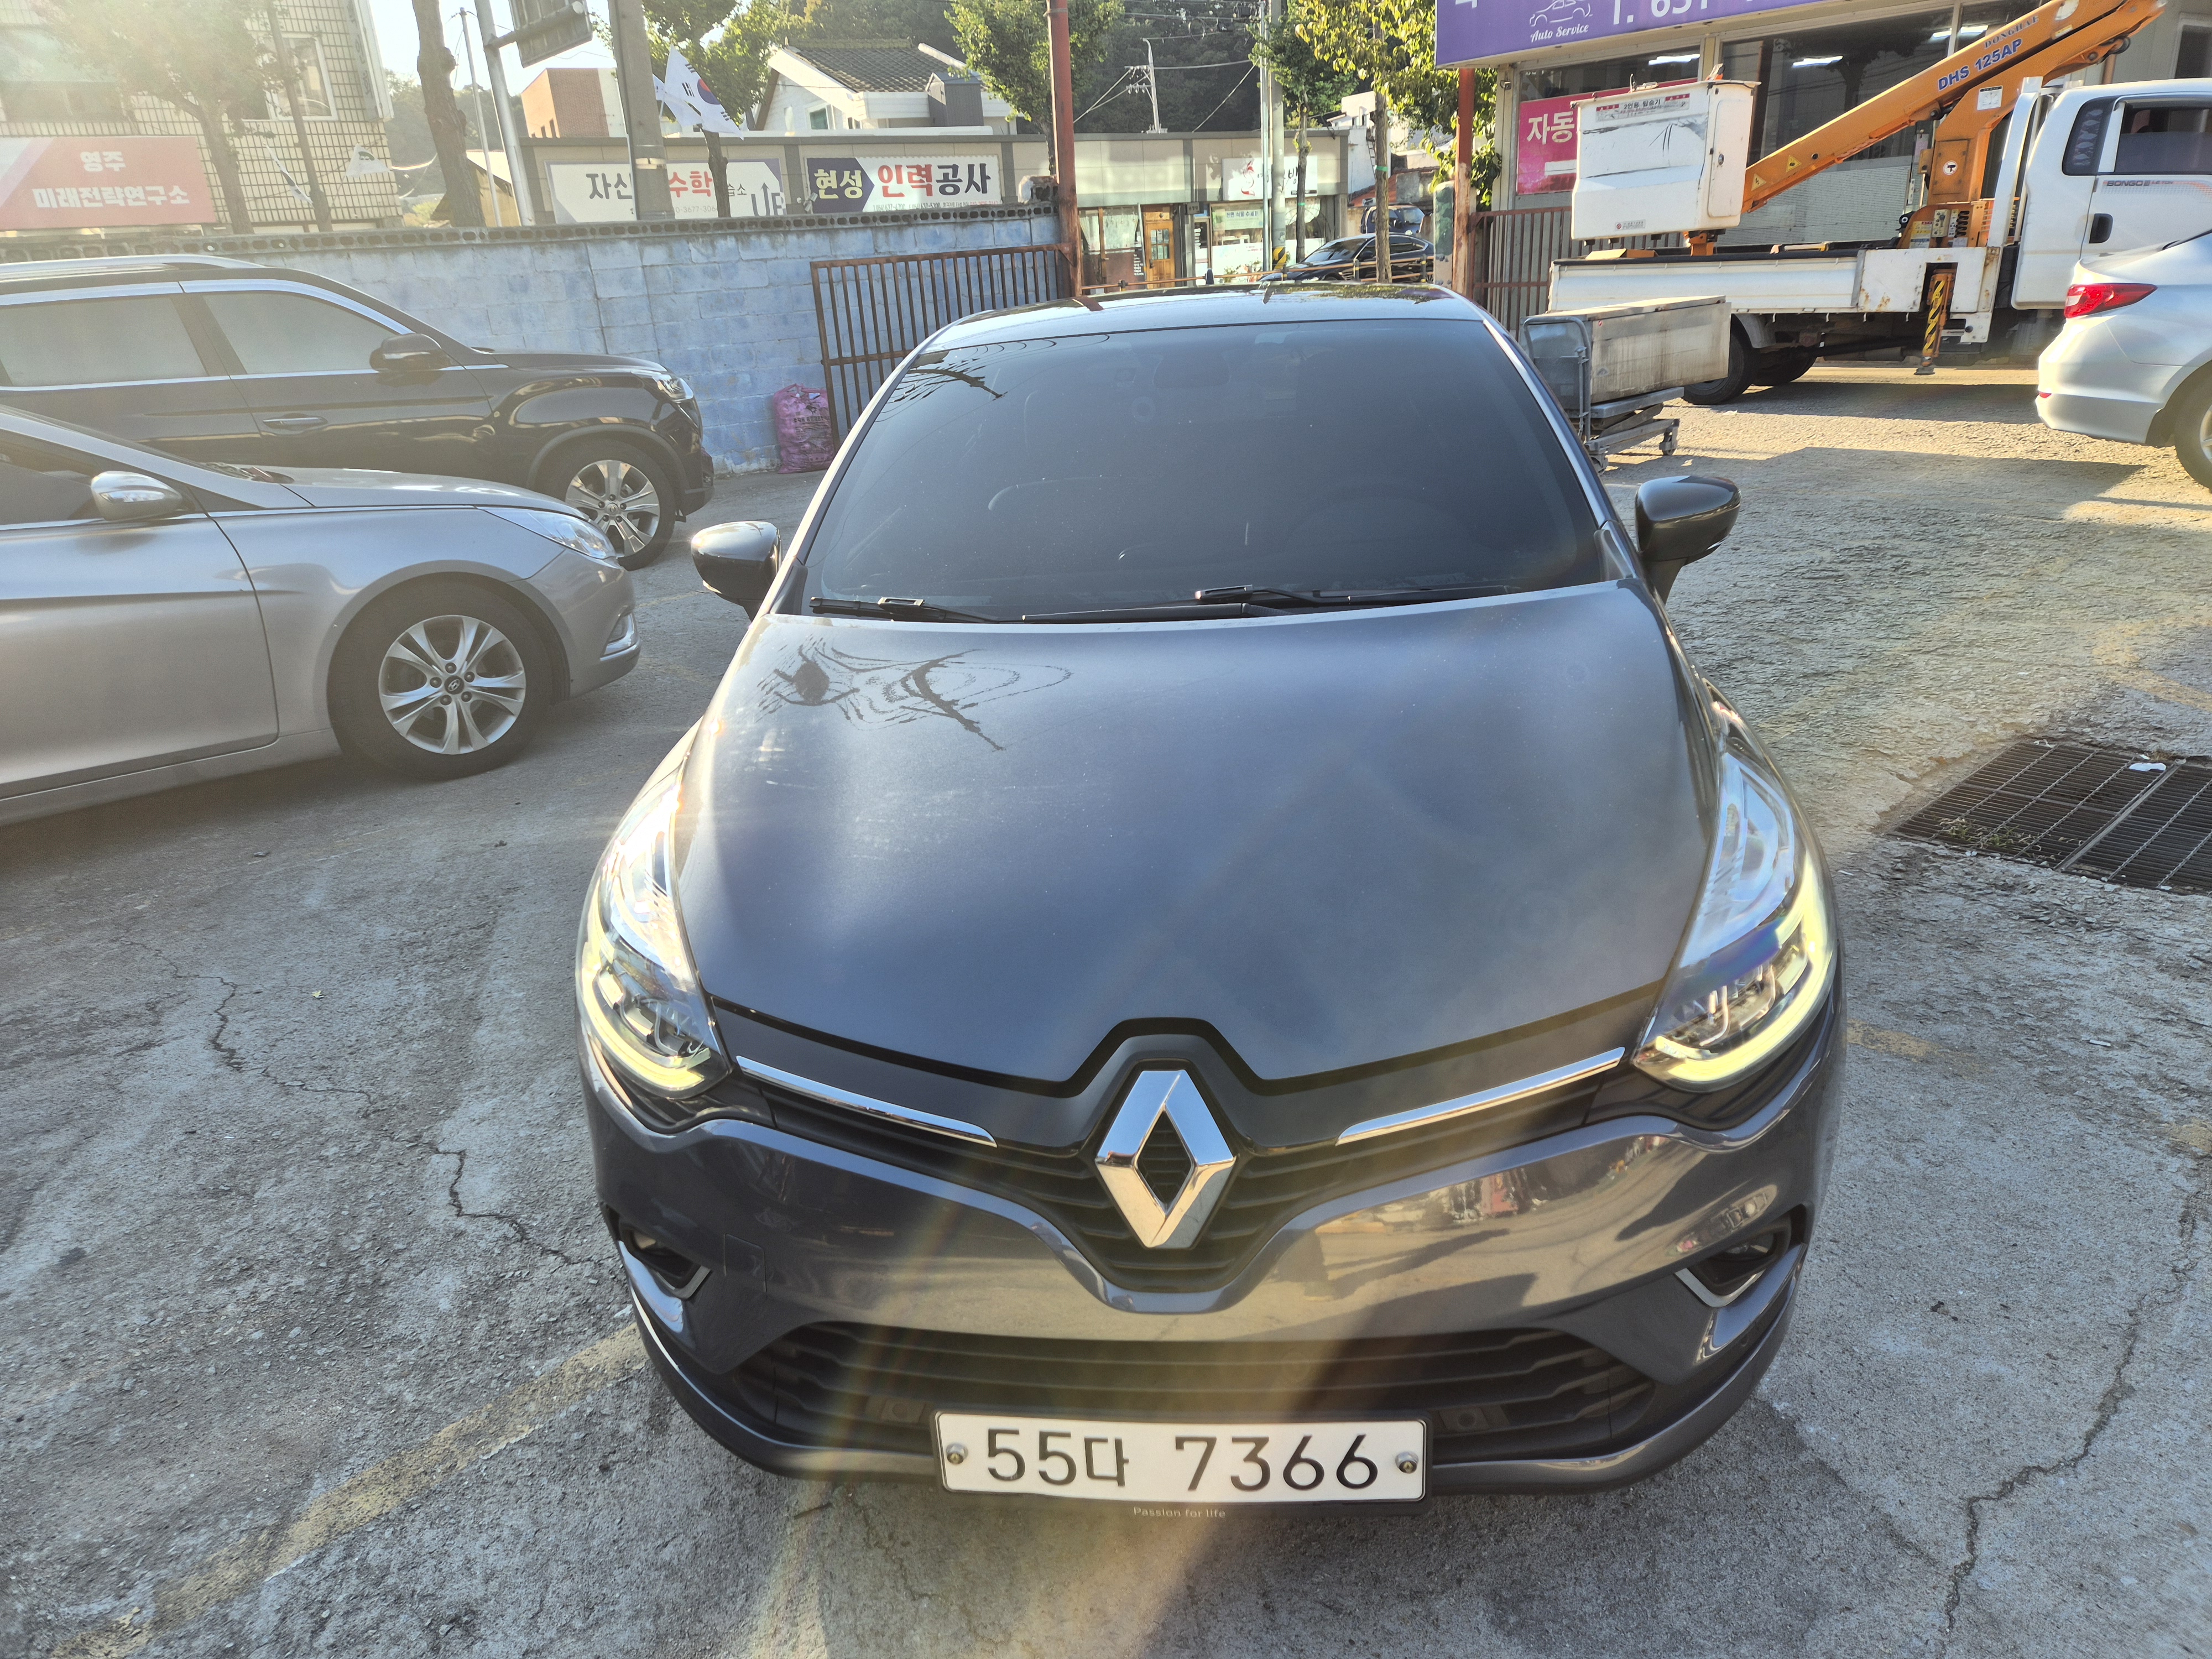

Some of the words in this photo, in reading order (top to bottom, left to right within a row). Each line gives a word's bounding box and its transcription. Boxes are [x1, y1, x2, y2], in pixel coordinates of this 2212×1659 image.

[1530, 30, 1553, 43] Auto
[1555, 23, 1589, 37] Service
[1985, 15, 2039, 49] DONGHAE
[1938, 66, 1970, 91] DHS
[1975, 38, 2023, 71] 125AP
[1527, 111, 1575, 145] 자동
[80, 151, 127, 172] 영주
[669, 171, 713, 198] 수학
[813, 169, 863, 199] 현성
[878, 163, 991, 197] 인력공사
[32, 185, 190, 208] 미래전략연구소
[987, 1427, 1129, 1488] 55다
[1175, 1433, 1379, 1492] 7366
[1134, 1506, 1182, 1517] Passion
[1185, 1509, 1203, 1518] for
[1206, 1509, 1226, 1519] life
